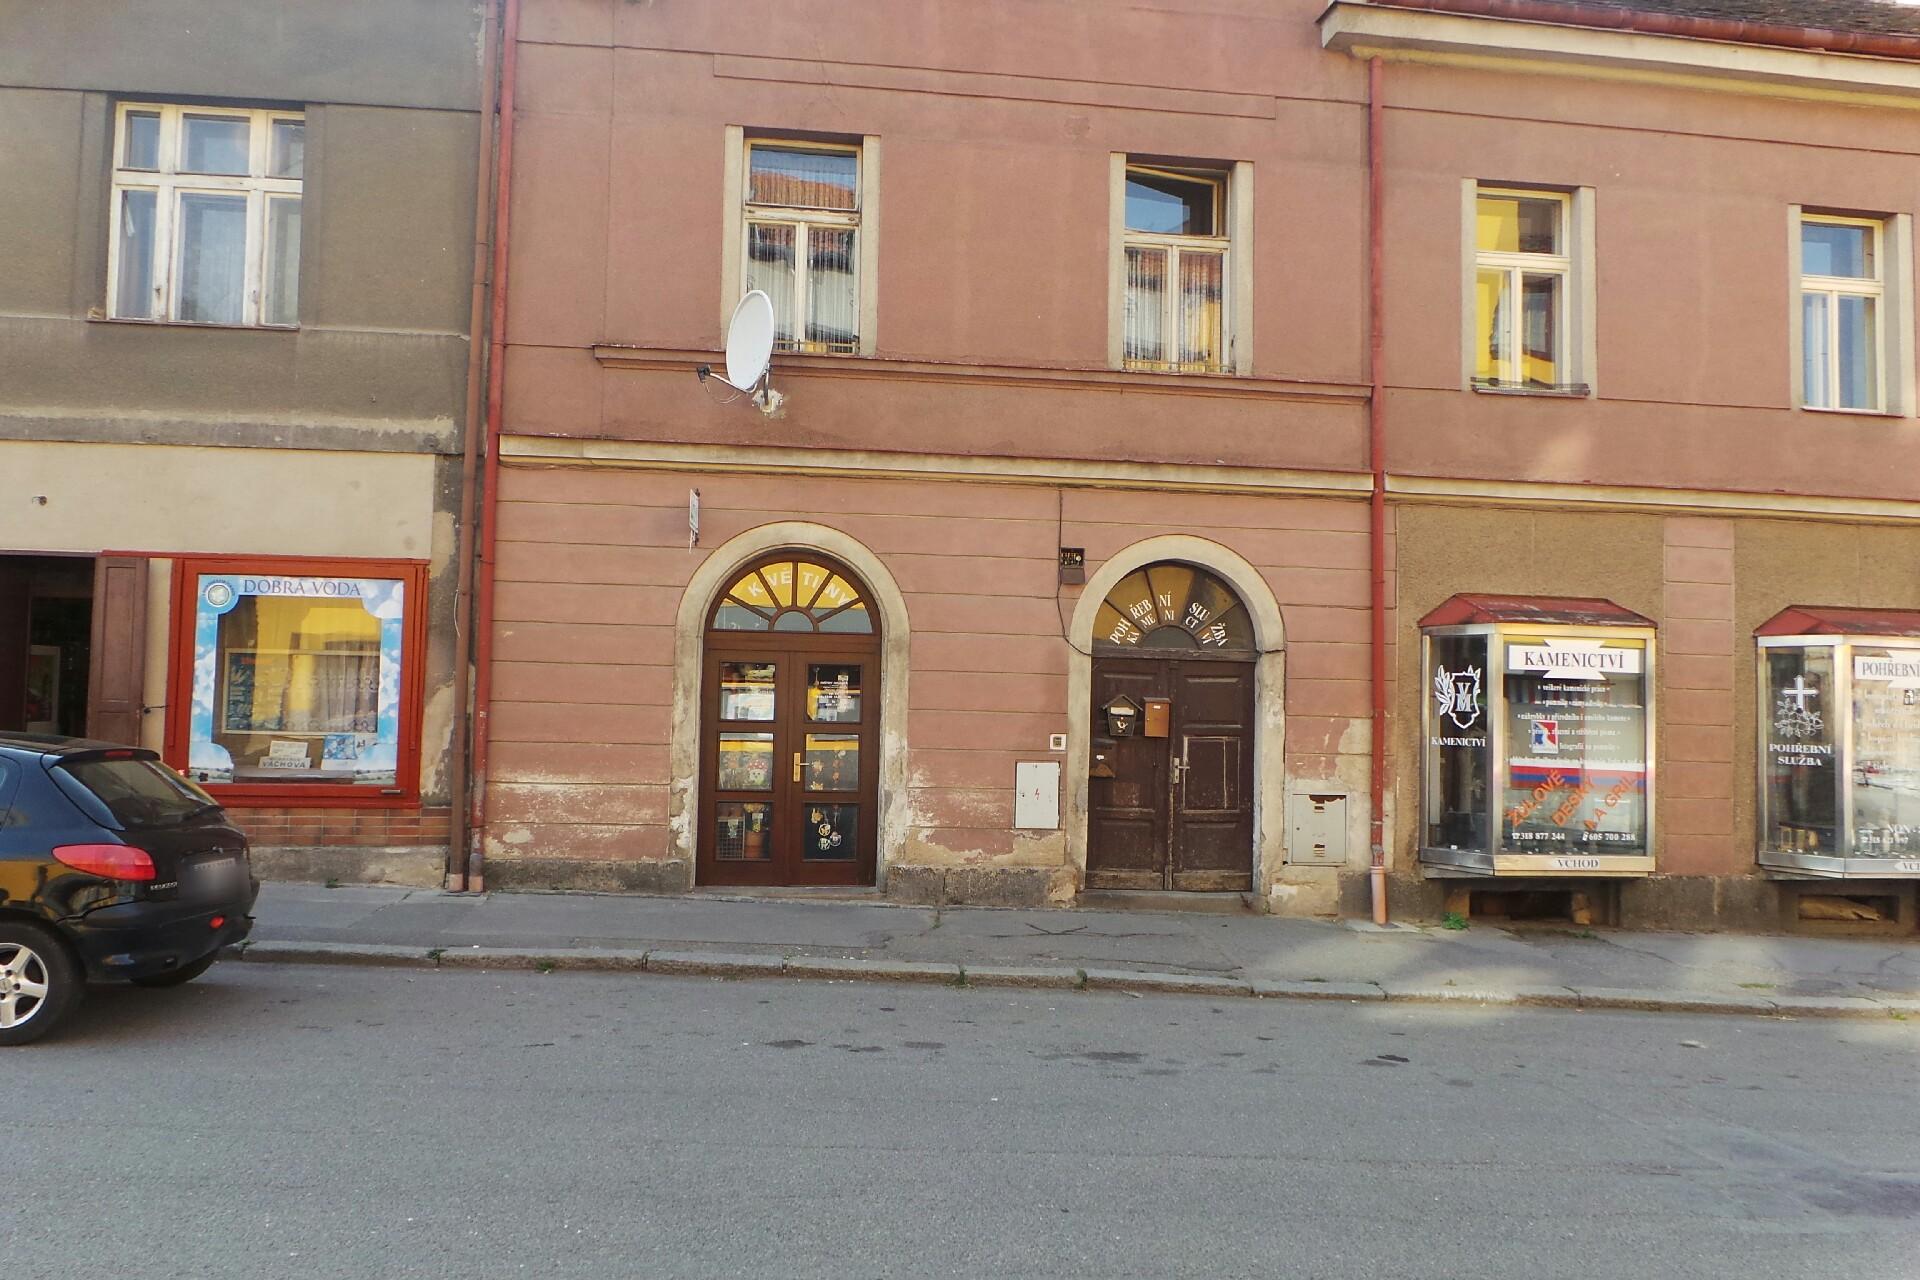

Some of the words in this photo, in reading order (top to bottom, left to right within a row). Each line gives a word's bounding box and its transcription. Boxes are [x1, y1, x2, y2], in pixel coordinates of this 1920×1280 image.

[311, 580, 361, 596] VODA
[1524, 650, 1624, 669] KAMENICTVÍ
[1431, 736, 1487, 747] KAMENICTVÍ
[1769, 742, 1832, 754] POHŘEBNÍ
[1777, 754, 1823, 766] SLUŽBA
[1557, 858, 1599, 868] VCHOD
